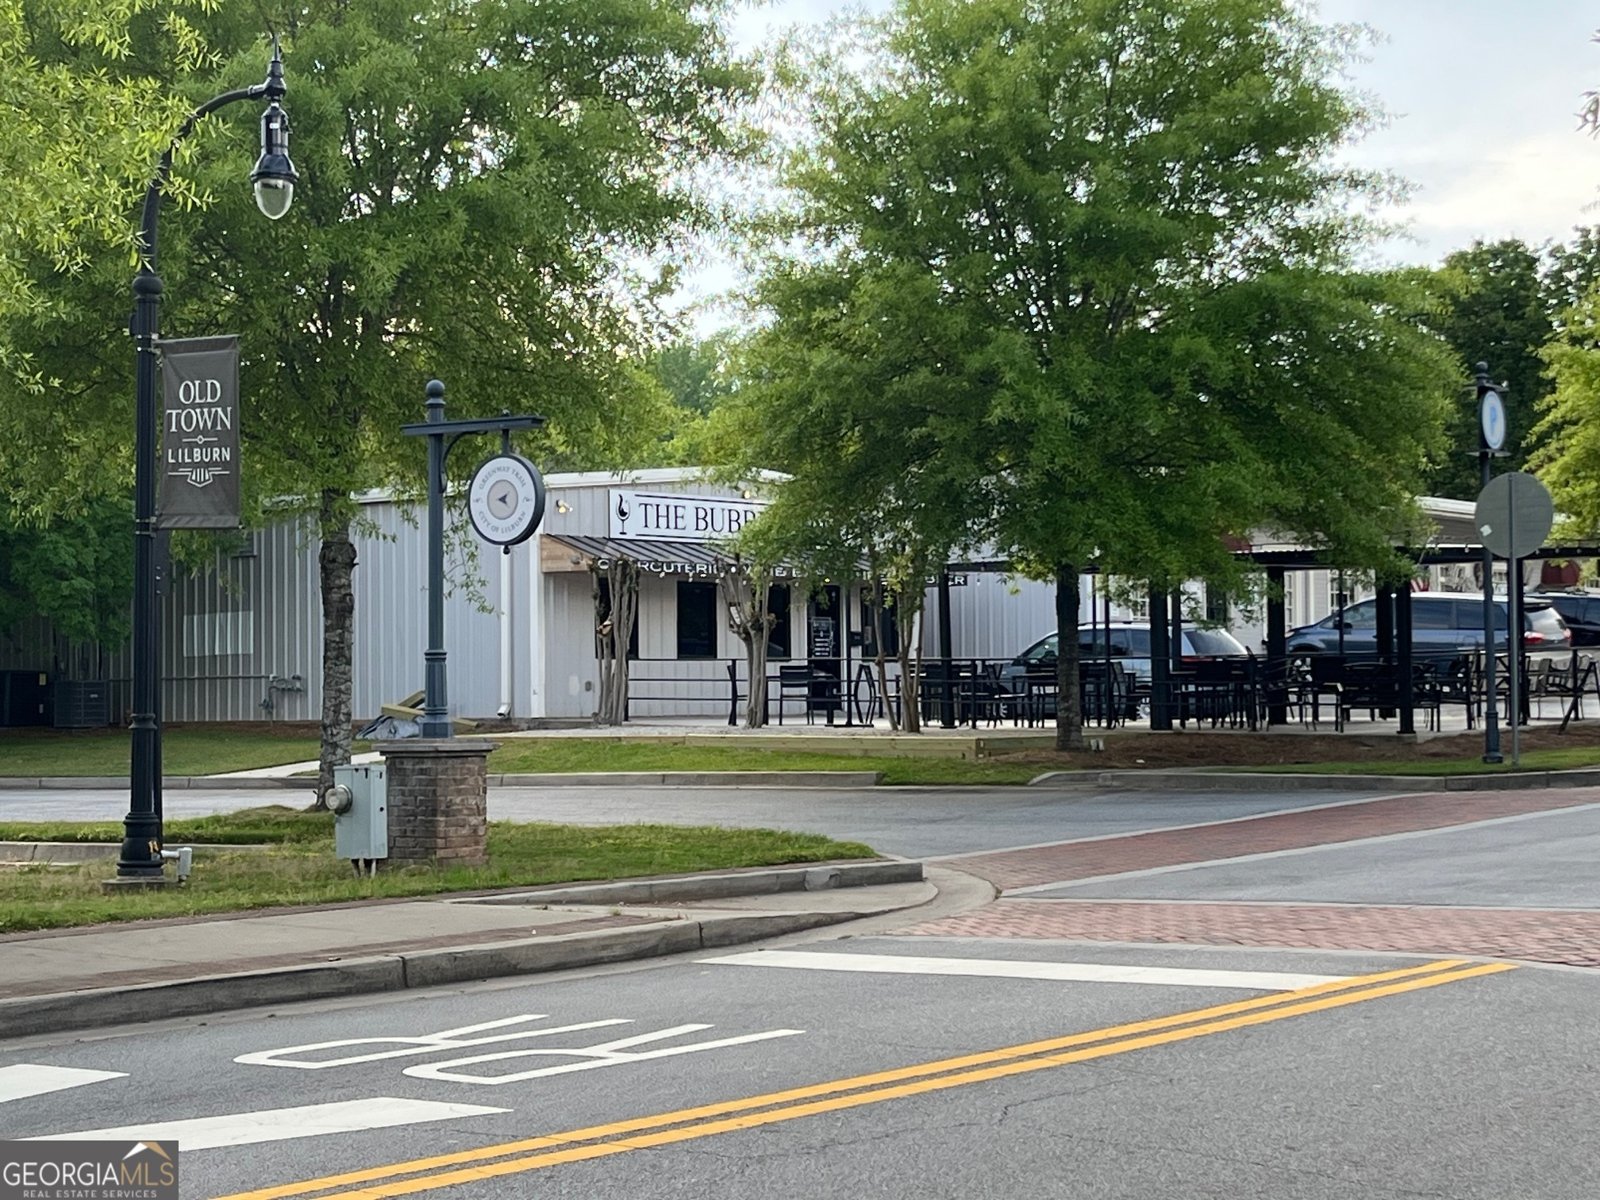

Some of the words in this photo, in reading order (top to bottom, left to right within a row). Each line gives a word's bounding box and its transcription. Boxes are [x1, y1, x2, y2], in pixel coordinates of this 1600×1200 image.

[179, 379, 221, 404] OLD
[166, 407, 232, 432] TOWN
[168, 447, 231, 463] LILBURN
[639, 503, 686, 530] THE
